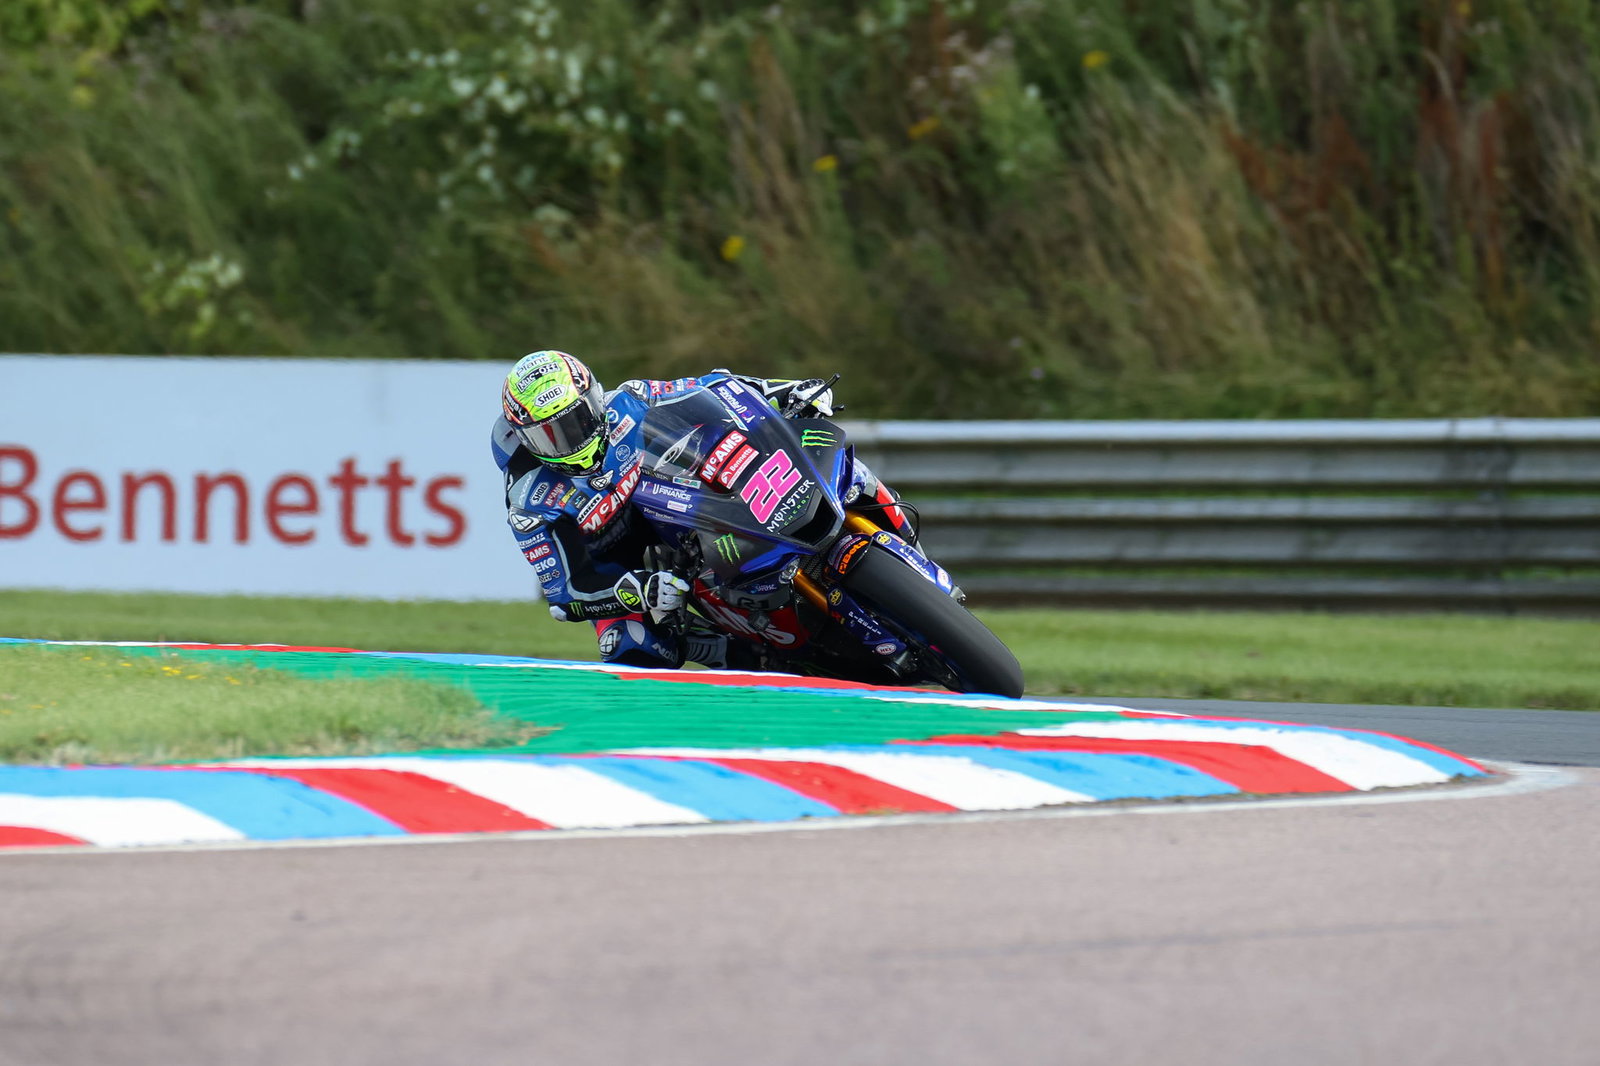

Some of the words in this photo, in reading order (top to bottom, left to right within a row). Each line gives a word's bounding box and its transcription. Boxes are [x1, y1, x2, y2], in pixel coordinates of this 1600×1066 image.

[537, 386, 563, 405] SHOEI
[729, 447, 753, 472] Bennetts
[0, 443, 468, 548] Bennetts
[532, 483, 549, 502] SHOEI
[658, 486, 693, 501] FINANCE
[740, 448, 802, 524] 22
[767, 479, 816, 532] MONSTER
[525, 545, 550, 561] AMS
[584, 601, 622, 614] MONST
